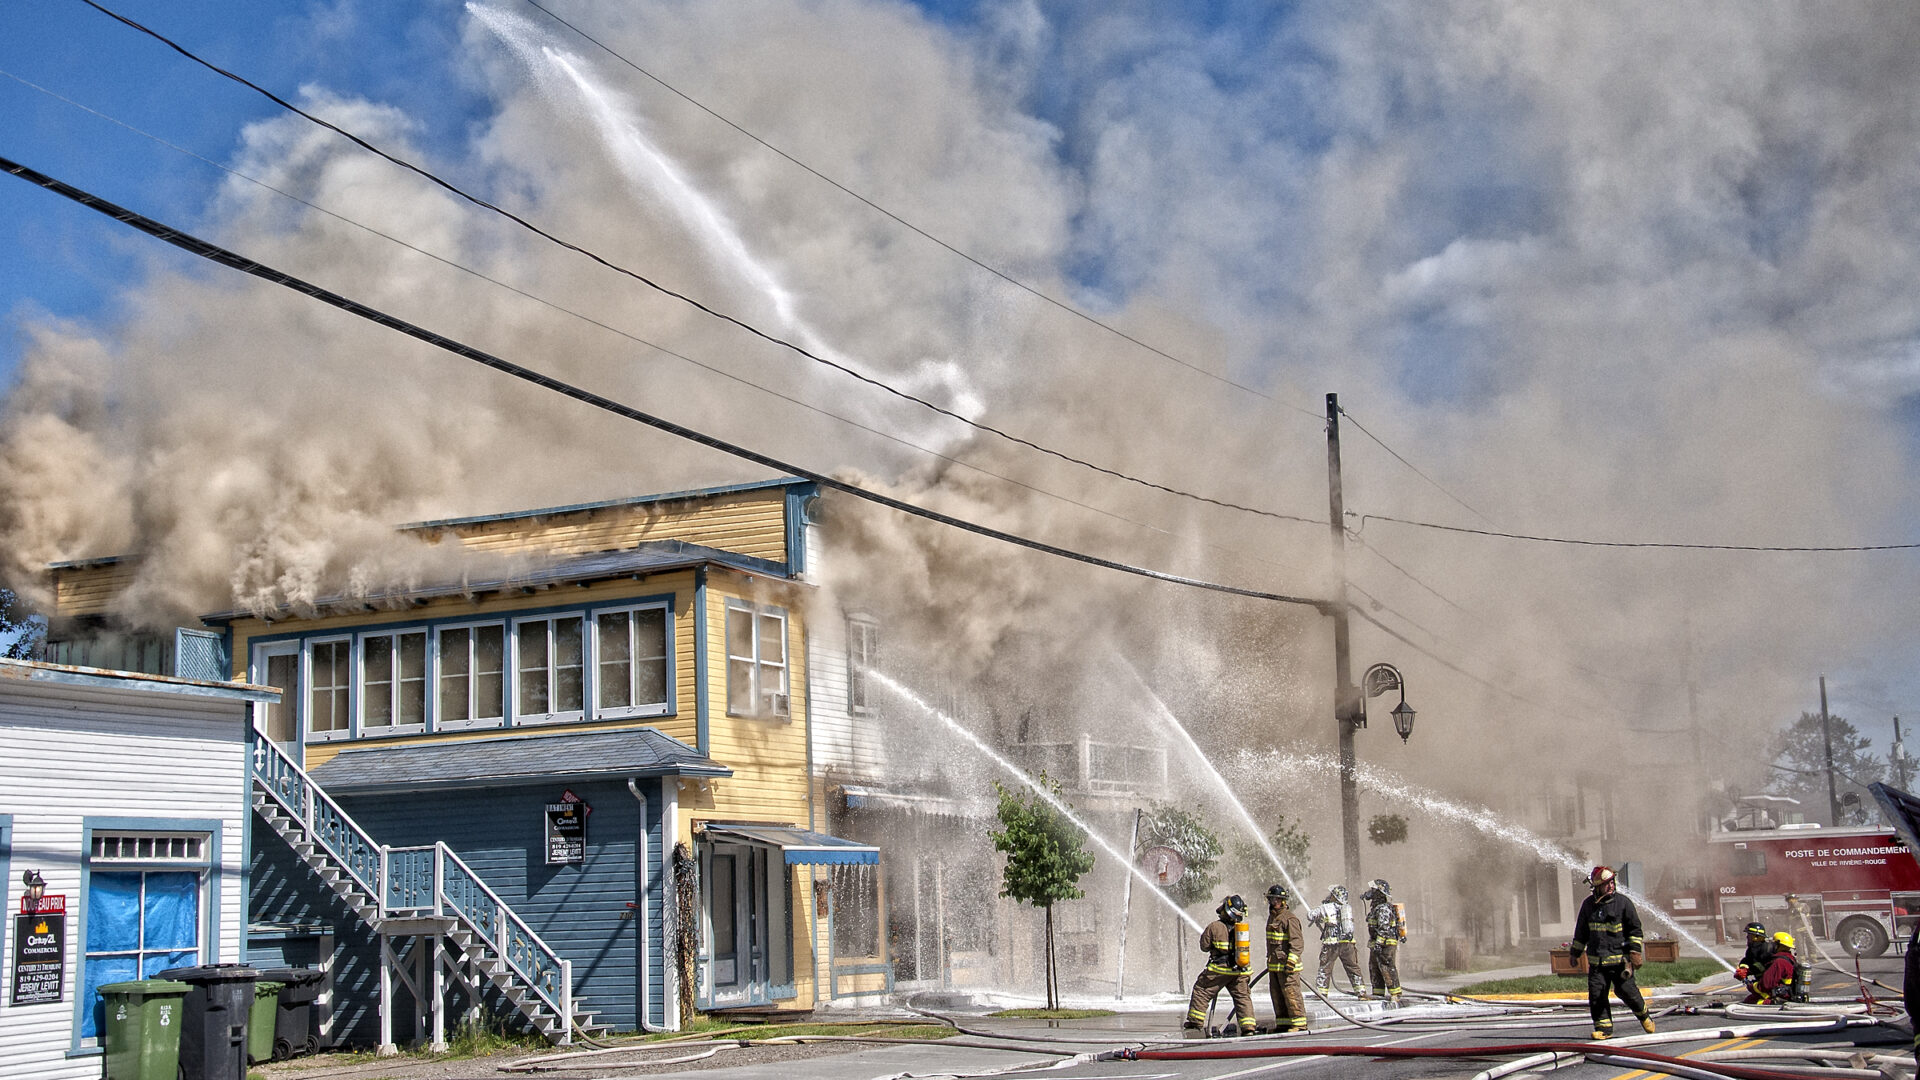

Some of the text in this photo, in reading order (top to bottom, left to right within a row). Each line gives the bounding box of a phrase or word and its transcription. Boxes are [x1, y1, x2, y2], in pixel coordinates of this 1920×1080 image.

[1785, 846, 1910, 858] POSTE DE COMMANDEMENT
[1720, 886, 1737, 894] 602
[50, 896, 64, 910] PRIX
[20, 973, 59, 983] 819 429-0204
[19, 980, 59, 993] JEREMY LEVITT
